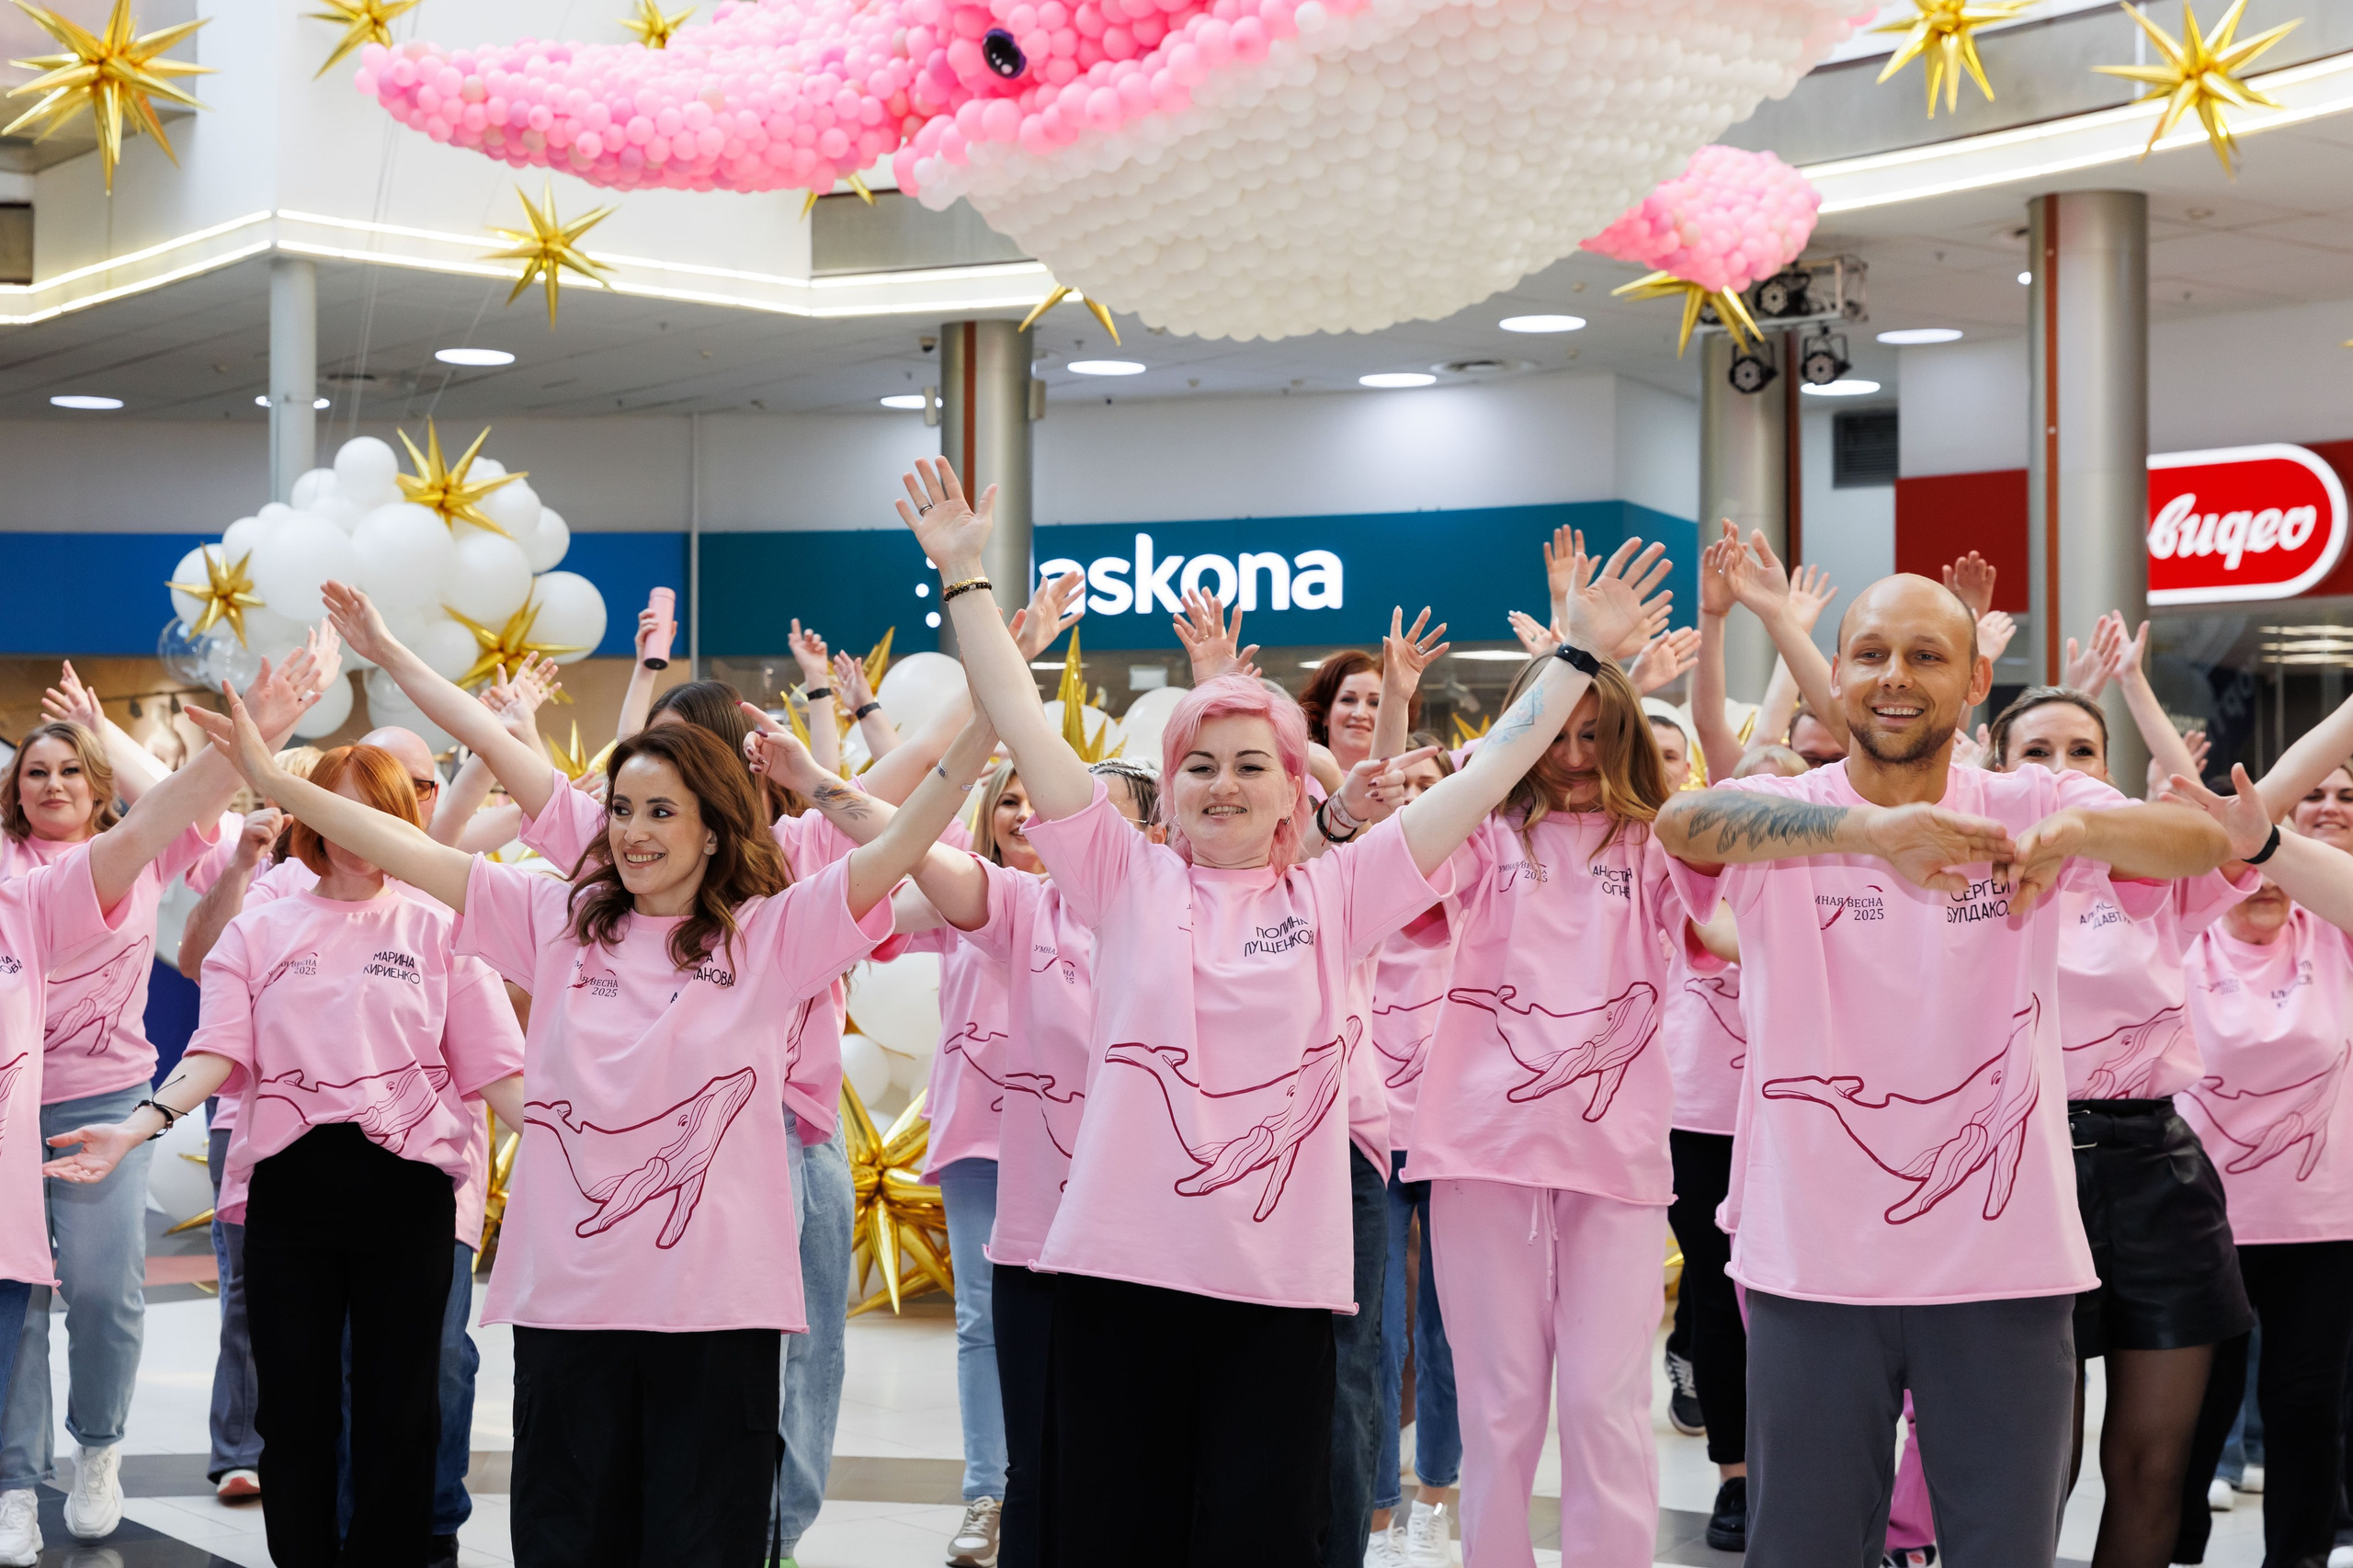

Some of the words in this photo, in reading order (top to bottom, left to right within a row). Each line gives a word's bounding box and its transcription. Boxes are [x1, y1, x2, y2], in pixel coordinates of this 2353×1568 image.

[2146, 493, 2317, 571] видео
[1039, 532, 1343, 616] askona
[1814, 894, 1844, 906] МНАЯ
[1847, 897, 1883, 908] ВЕСНА
[1853, 908, 1884, 921] 2025
[1947, 899, 2010, 924] БУЛДАКО
[1033, 944, 1058, 956] УМНА
[372, 950, 415, 969] МАРИНА
[293, 966, 317, 976] 2025
[362, 963, 421, 984] КИРИЕНКО
[589, 978, 619, 988] ВЕСНА
[591, 986, 619, 998] 2025
